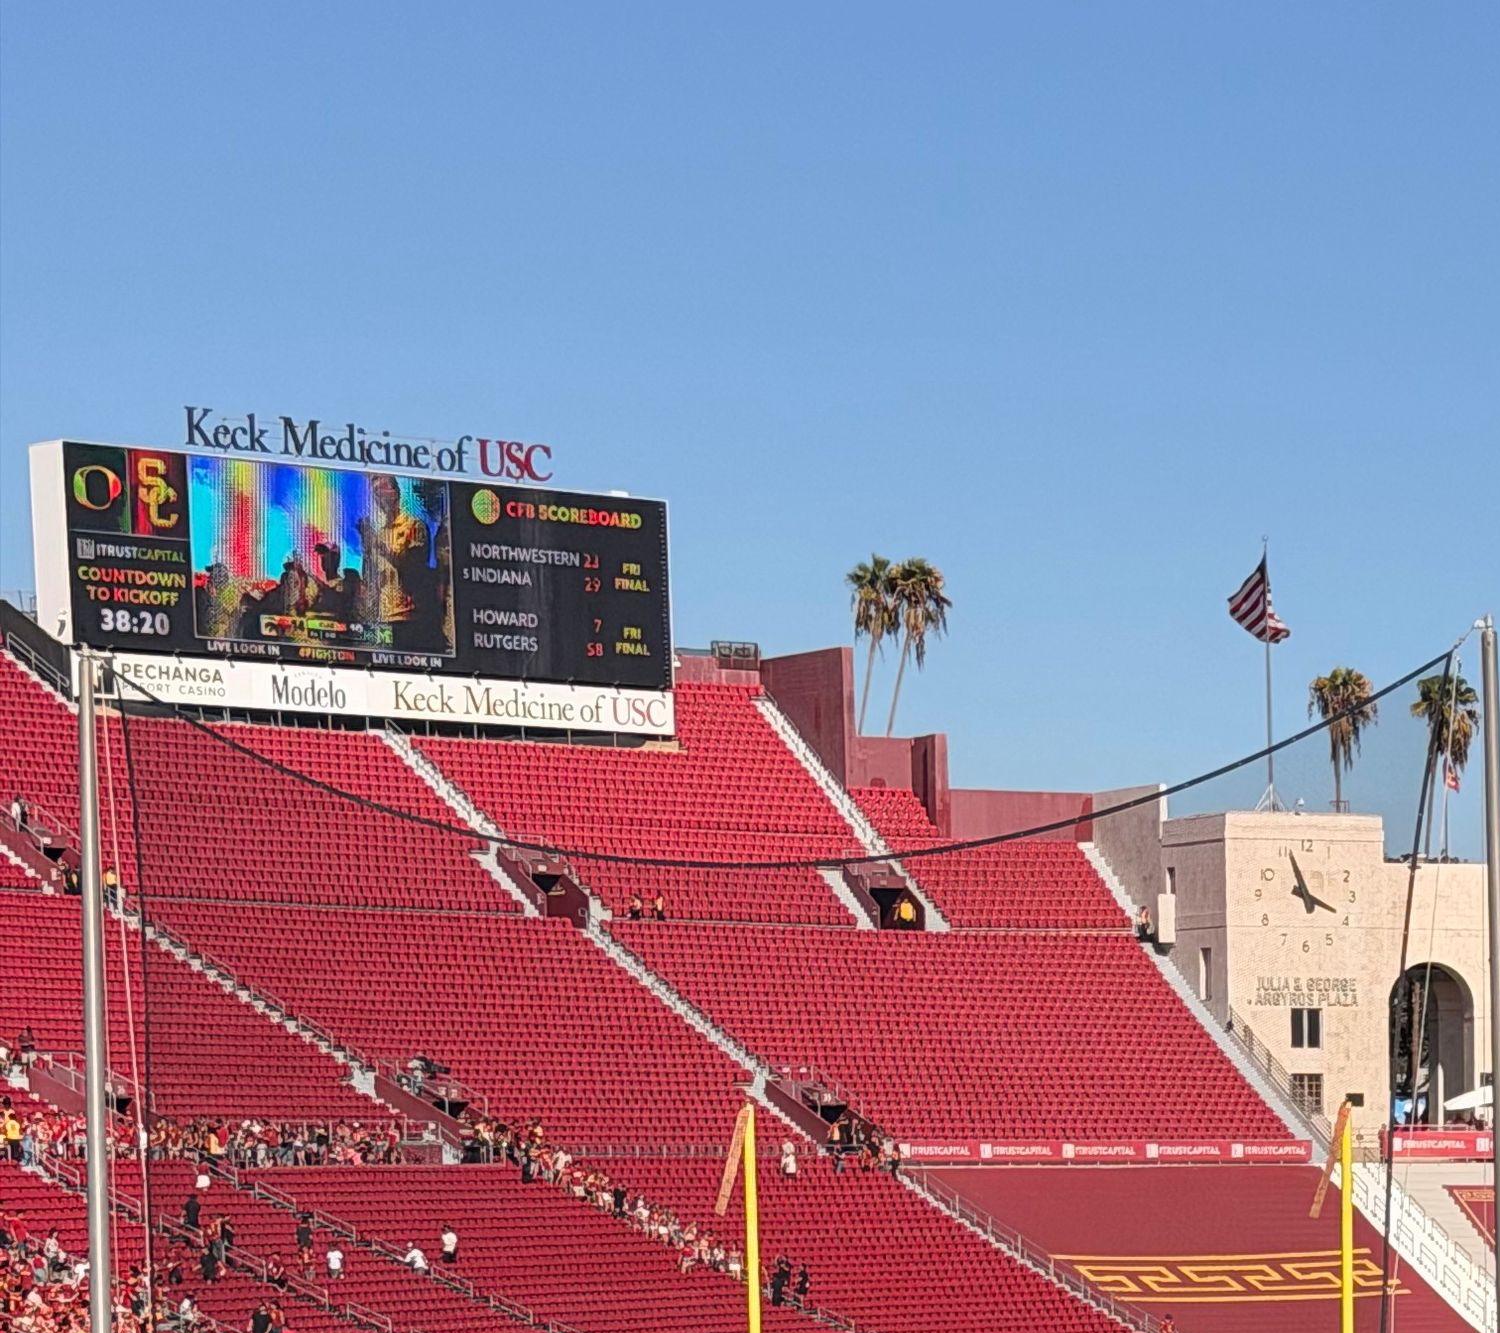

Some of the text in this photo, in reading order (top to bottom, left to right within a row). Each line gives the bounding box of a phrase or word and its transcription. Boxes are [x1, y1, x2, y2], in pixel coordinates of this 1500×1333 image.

[185, 407, 553, 482] Keck Medicine of USC
[505, 501, 642, 529] CFB SCOREBOARD
[470, 543, 580, 567] NORTHWESTERN
[78, 566, 186, 588] COUNTDOWN
[472, 567, 532, 586] INDIANA
[622, 563, 640, 575] FRI
[86, 585, 179, 606] TO KICKOFF
[614, 578, 650, 592] FINAL
[100, 609, 169, 636] 38:20
[473, 609, 601, 633] HOWARD 7
[474, 633, 538, 652] RUTGERS
[624, 627, 641, 639] FRI
[267, 644, 280, 655] IN
[615, 642, 650, 656] FINAL
[430, 656, 442, 667] IN
[121, 663, 224, 684] PECHANGA
[179, 684, 226, 697] CASINO
[271, 674, 346, 709] Modelo
[393, 680, 667, 728] Keck Medicine of USC
